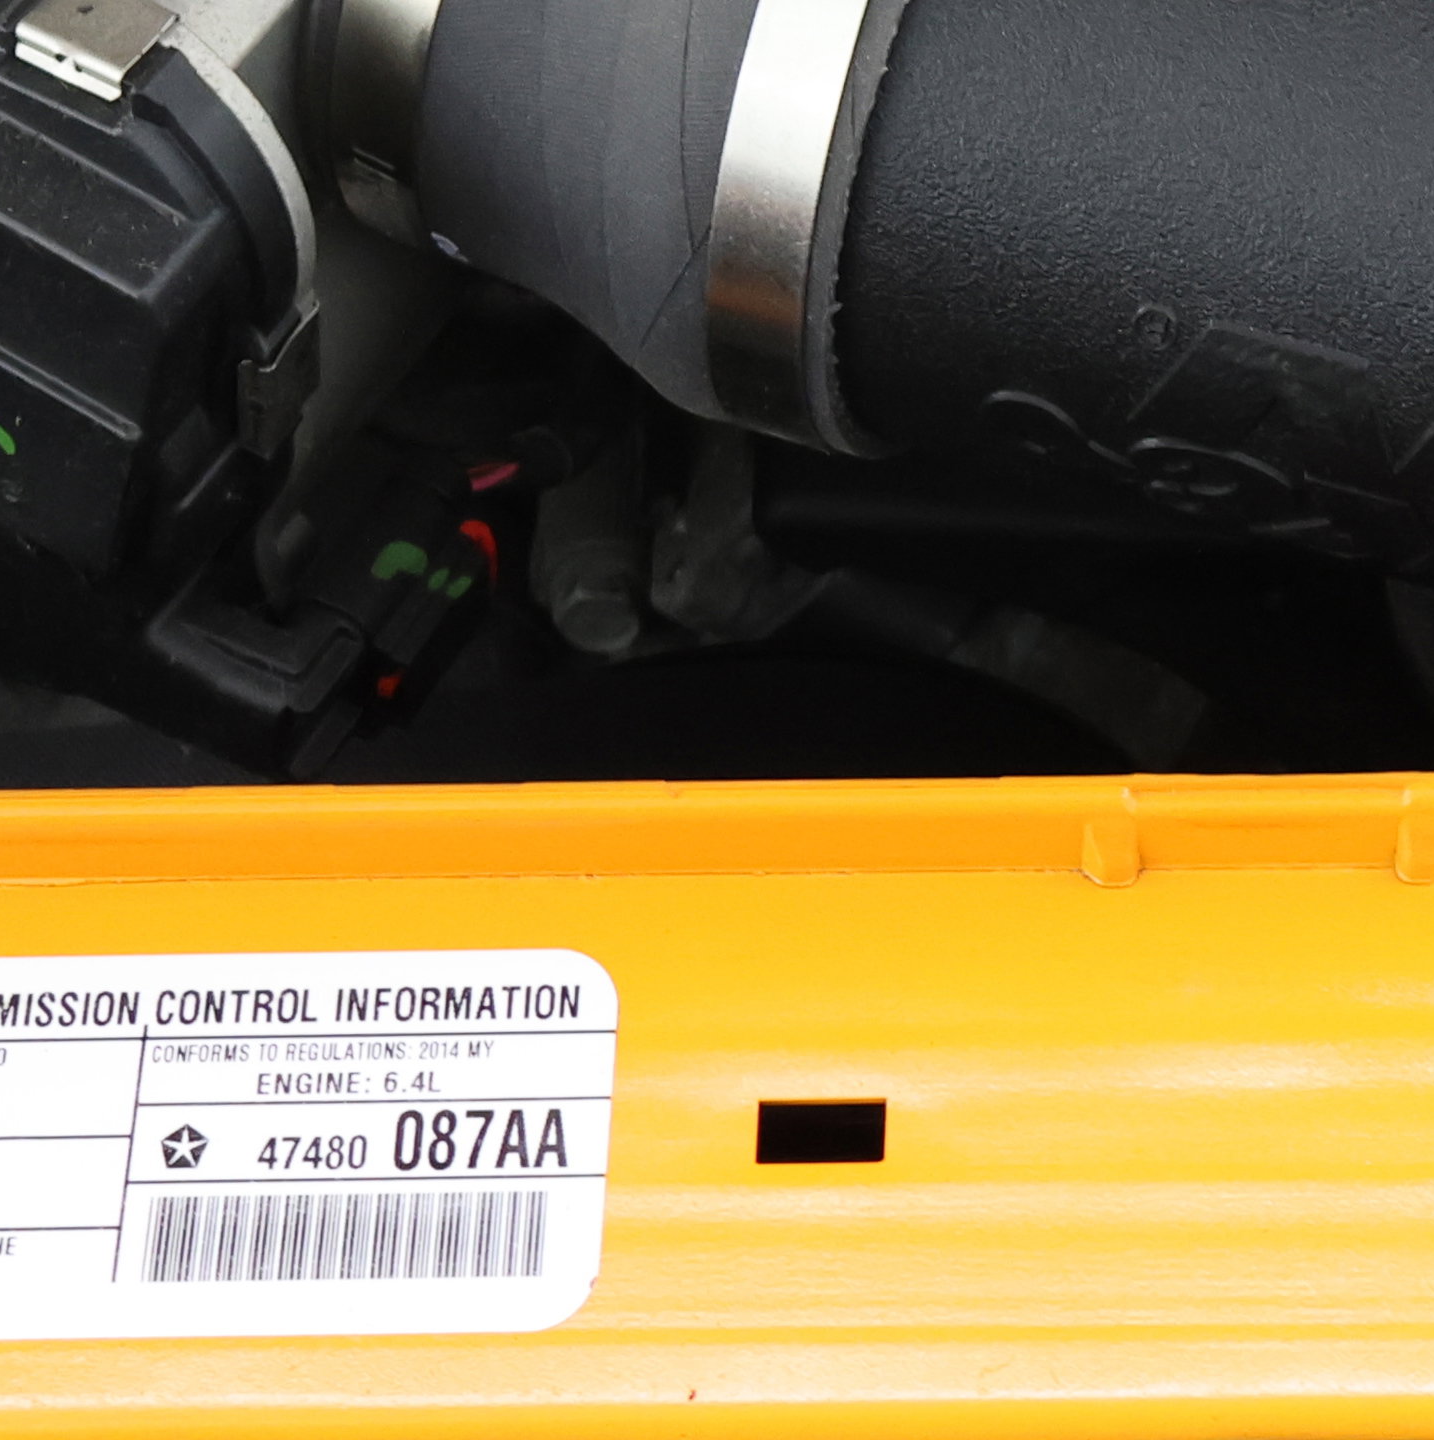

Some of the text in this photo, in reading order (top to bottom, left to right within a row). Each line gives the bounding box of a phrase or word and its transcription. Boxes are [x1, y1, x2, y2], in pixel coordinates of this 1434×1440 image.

[156, 988, 317, 1025] CONTROL
[335, 984, 580, 1022] INFORMATION
[153, 1042, 492, 1062] CONFORMS TO REGULATIONS: 2014 MY
[257, 1072, 439, 1094] ENGINE: 6.4L
[257, 1109, 567, 1171] 47480 087AA
